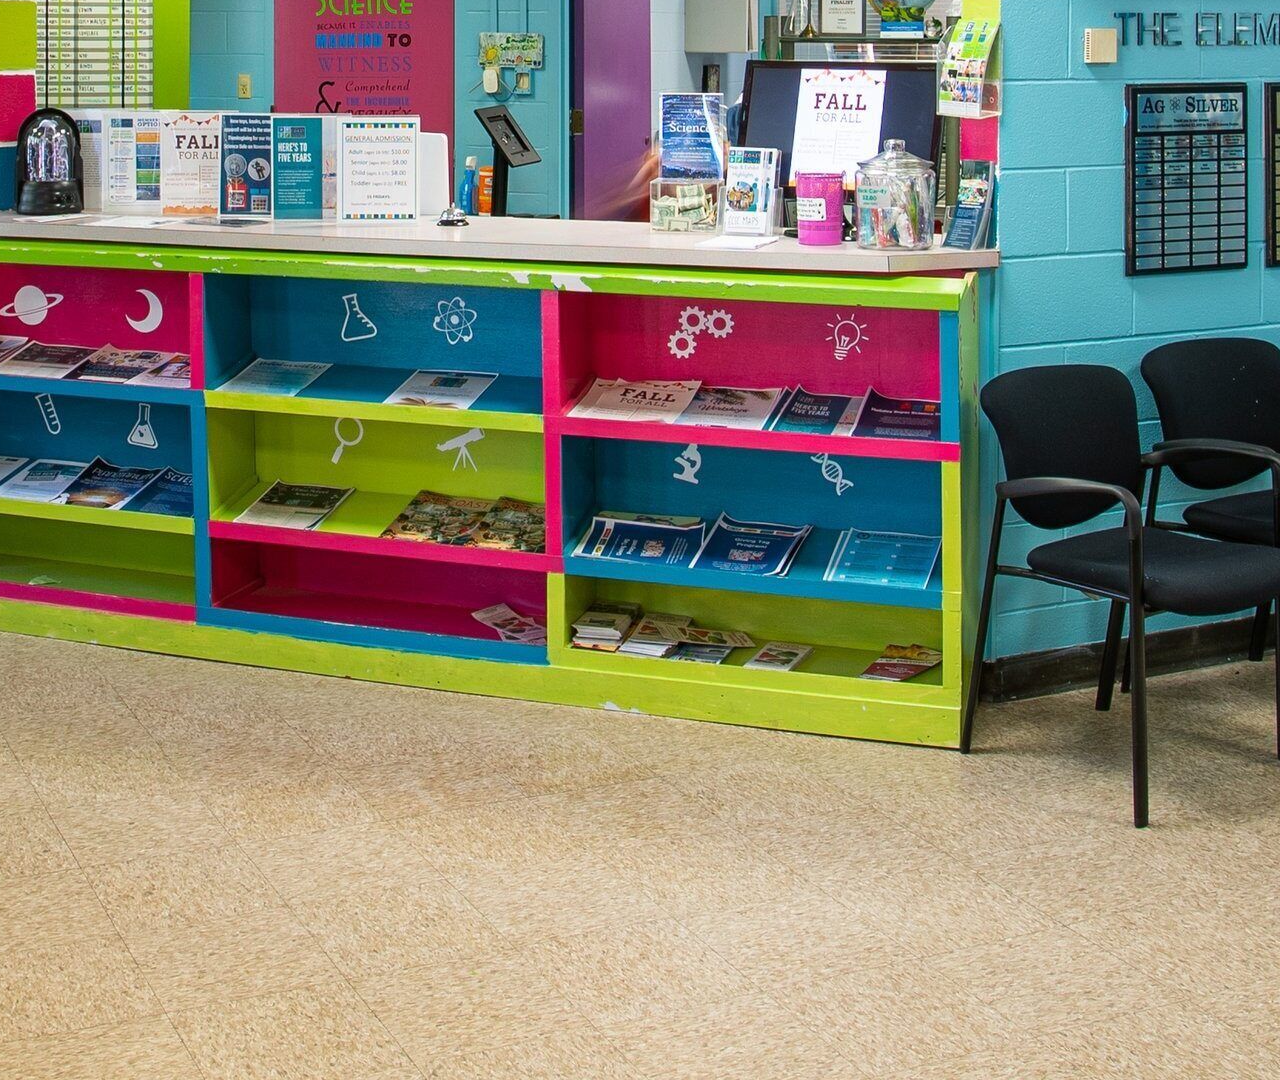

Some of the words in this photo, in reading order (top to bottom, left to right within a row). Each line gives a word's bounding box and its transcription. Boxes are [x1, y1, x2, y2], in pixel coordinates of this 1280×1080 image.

[1114, 12, 1183, 47] THE
[387, 33, 412, 47] TO
[318, 55, 412, 73] WITNESS
[345, 80, 411, 94] Comprehend
[814, 92, 867, 111] FALL
[816, 112, 837, 123] FOR
[840, 113, 862, 124] ALL
[299, 142, 307, 151] TO
[178, 151, 199, 160] FOR
[277, 152, 291, 162] FIVE
[292, 152, 312, 162] YEARS
[620, 387, 676, 403] FALL
[619, 397, 644, 405] FOR
[646, 399, 668, 408] ALL
